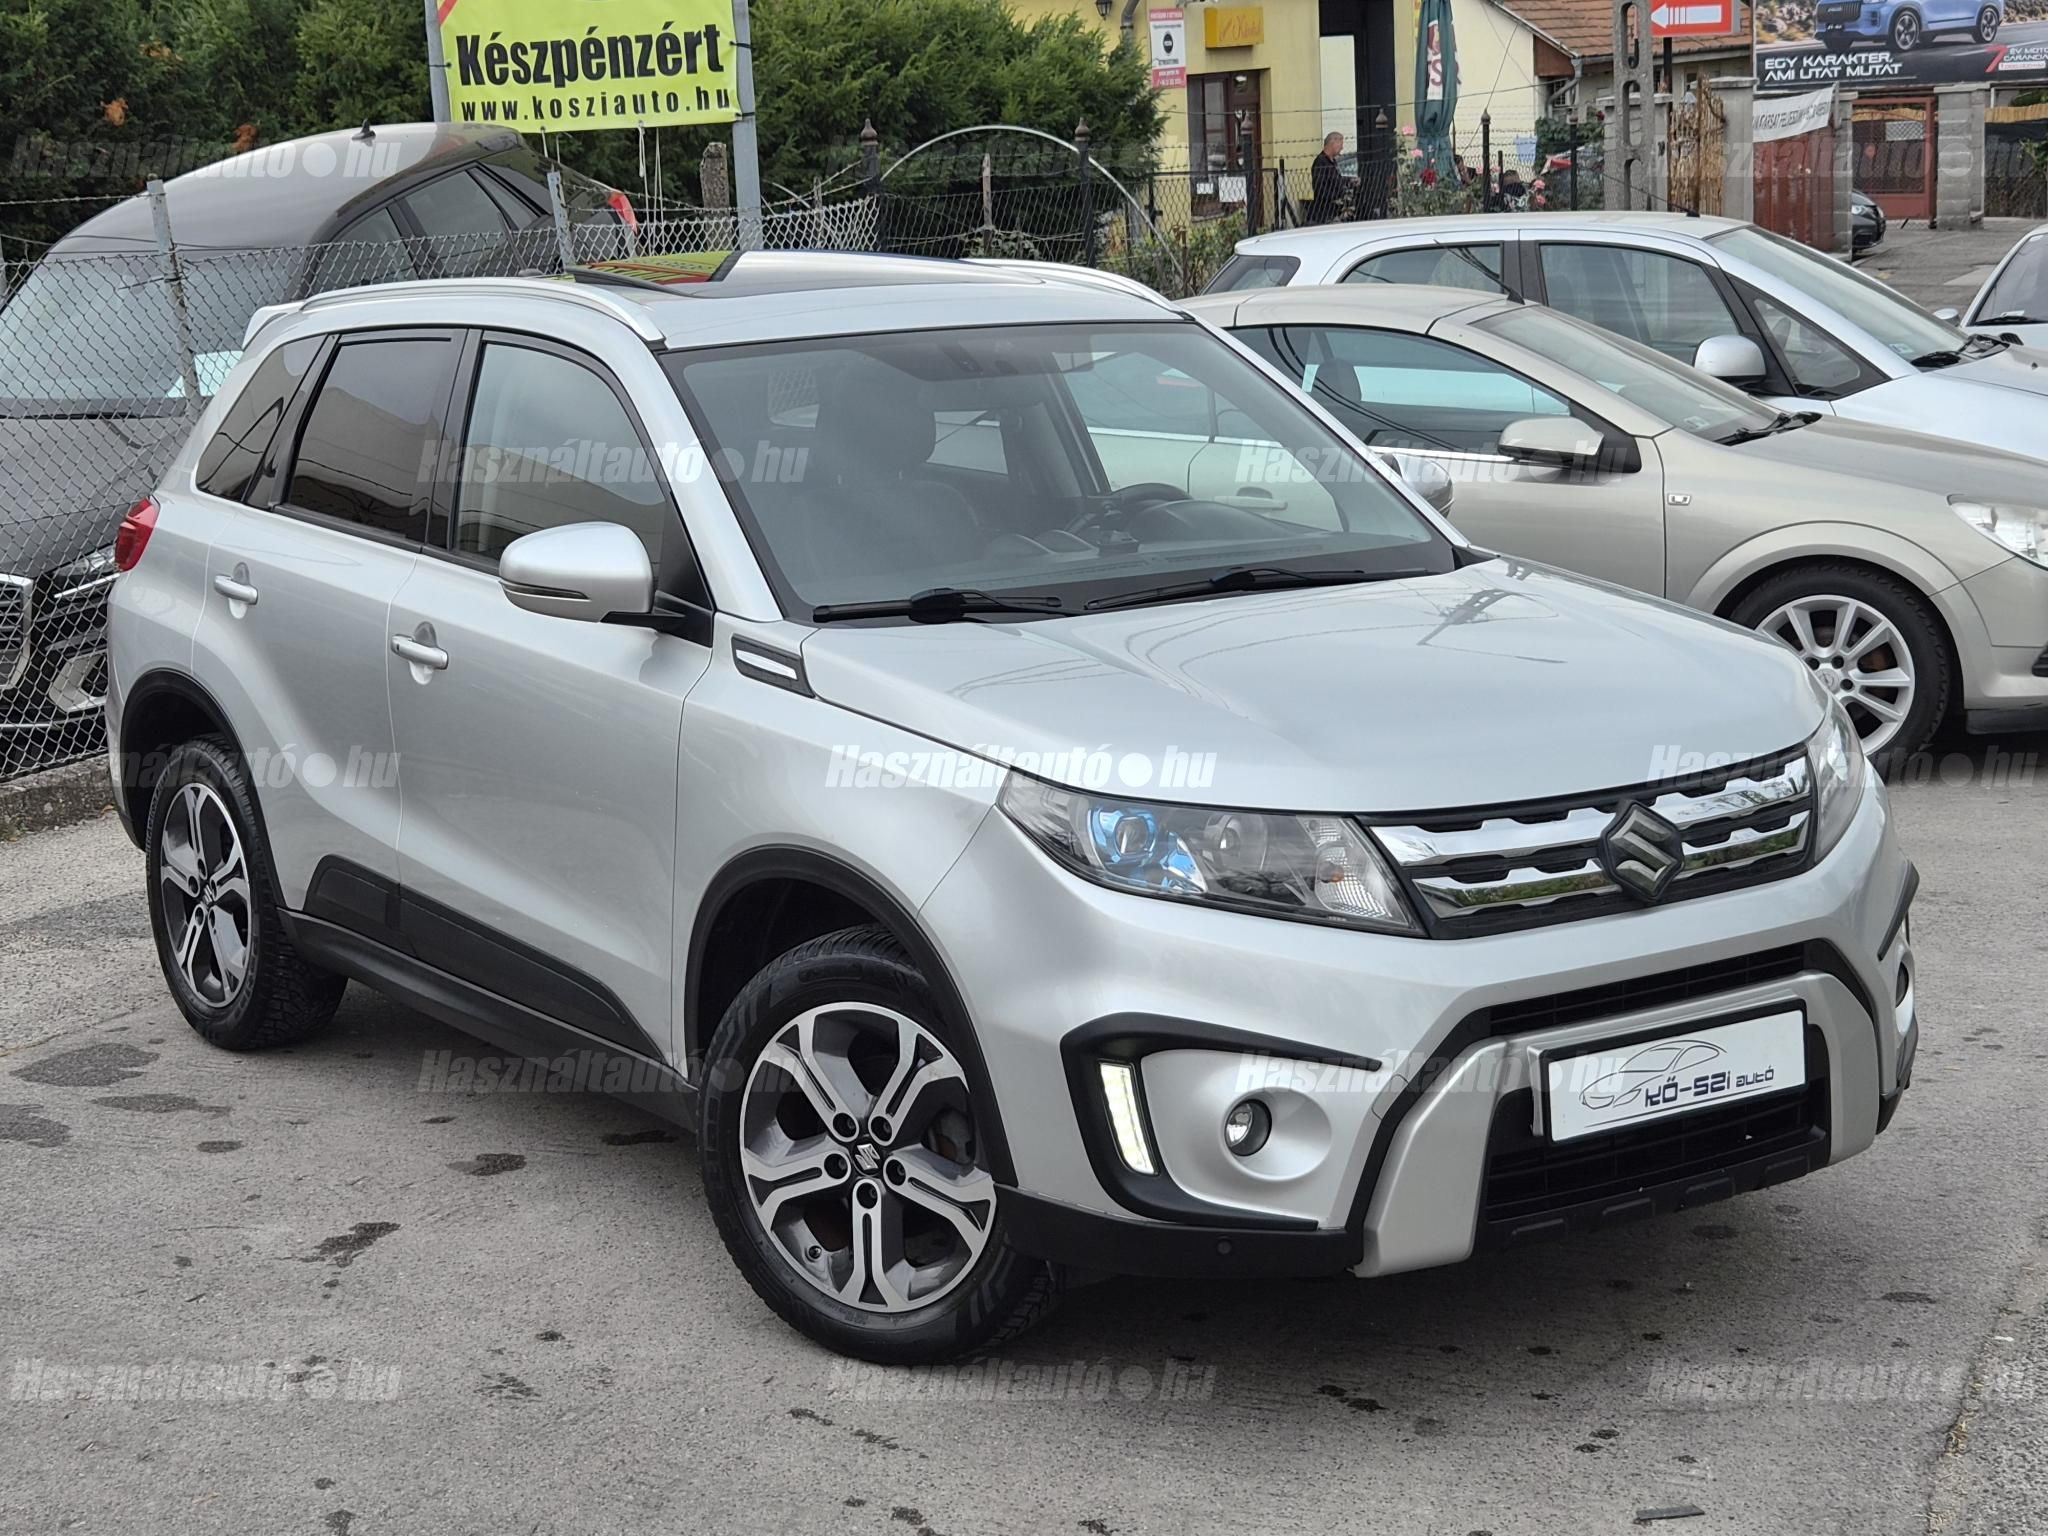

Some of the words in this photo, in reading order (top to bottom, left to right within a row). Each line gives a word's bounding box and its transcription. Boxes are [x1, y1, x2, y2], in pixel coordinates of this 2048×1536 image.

[456, 21, 725, 88] Készpénzért
[1764, 57, 1798, 70] EGY
[1802, 51, 1894, 68] KARAKTER,
[1984, 44, 2008, 73] 7
[1764, 69, 1795, 82] AMI
[1799, 66, 1841, 80] UTAT
[1846, 62, 1903, 77] MUTAT
[461, 86, 730, 121] www.kosziauto.hu
